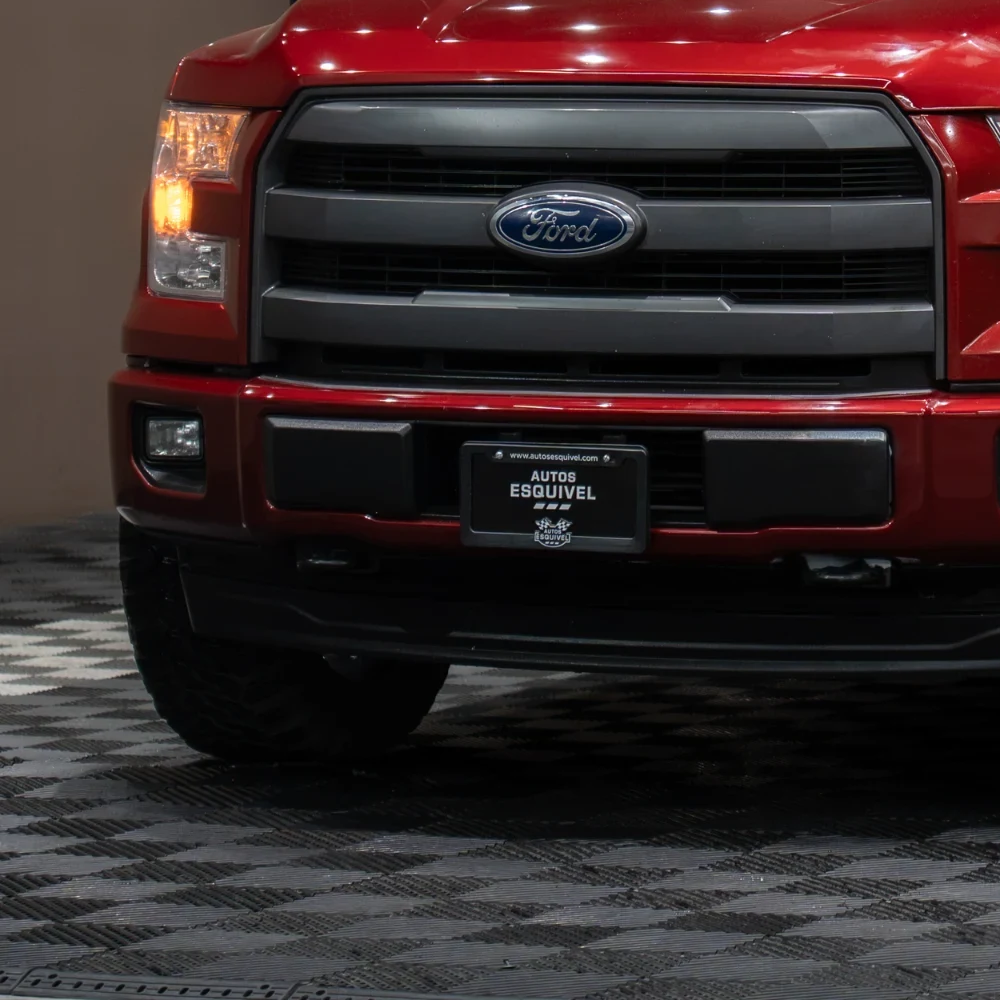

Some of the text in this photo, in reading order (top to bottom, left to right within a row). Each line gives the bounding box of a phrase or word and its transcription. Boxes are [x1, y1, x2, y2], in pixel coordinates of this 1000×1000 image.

[521, 207, 598, 243] Ford
[509, 452, 599, 463] www.autosesquivel.com
[530, 470, 577, 483] AUTOS
[509, 483, 597, 501] ESQUIVEL
[535, 533, 569, 542] ESQUIVEL
